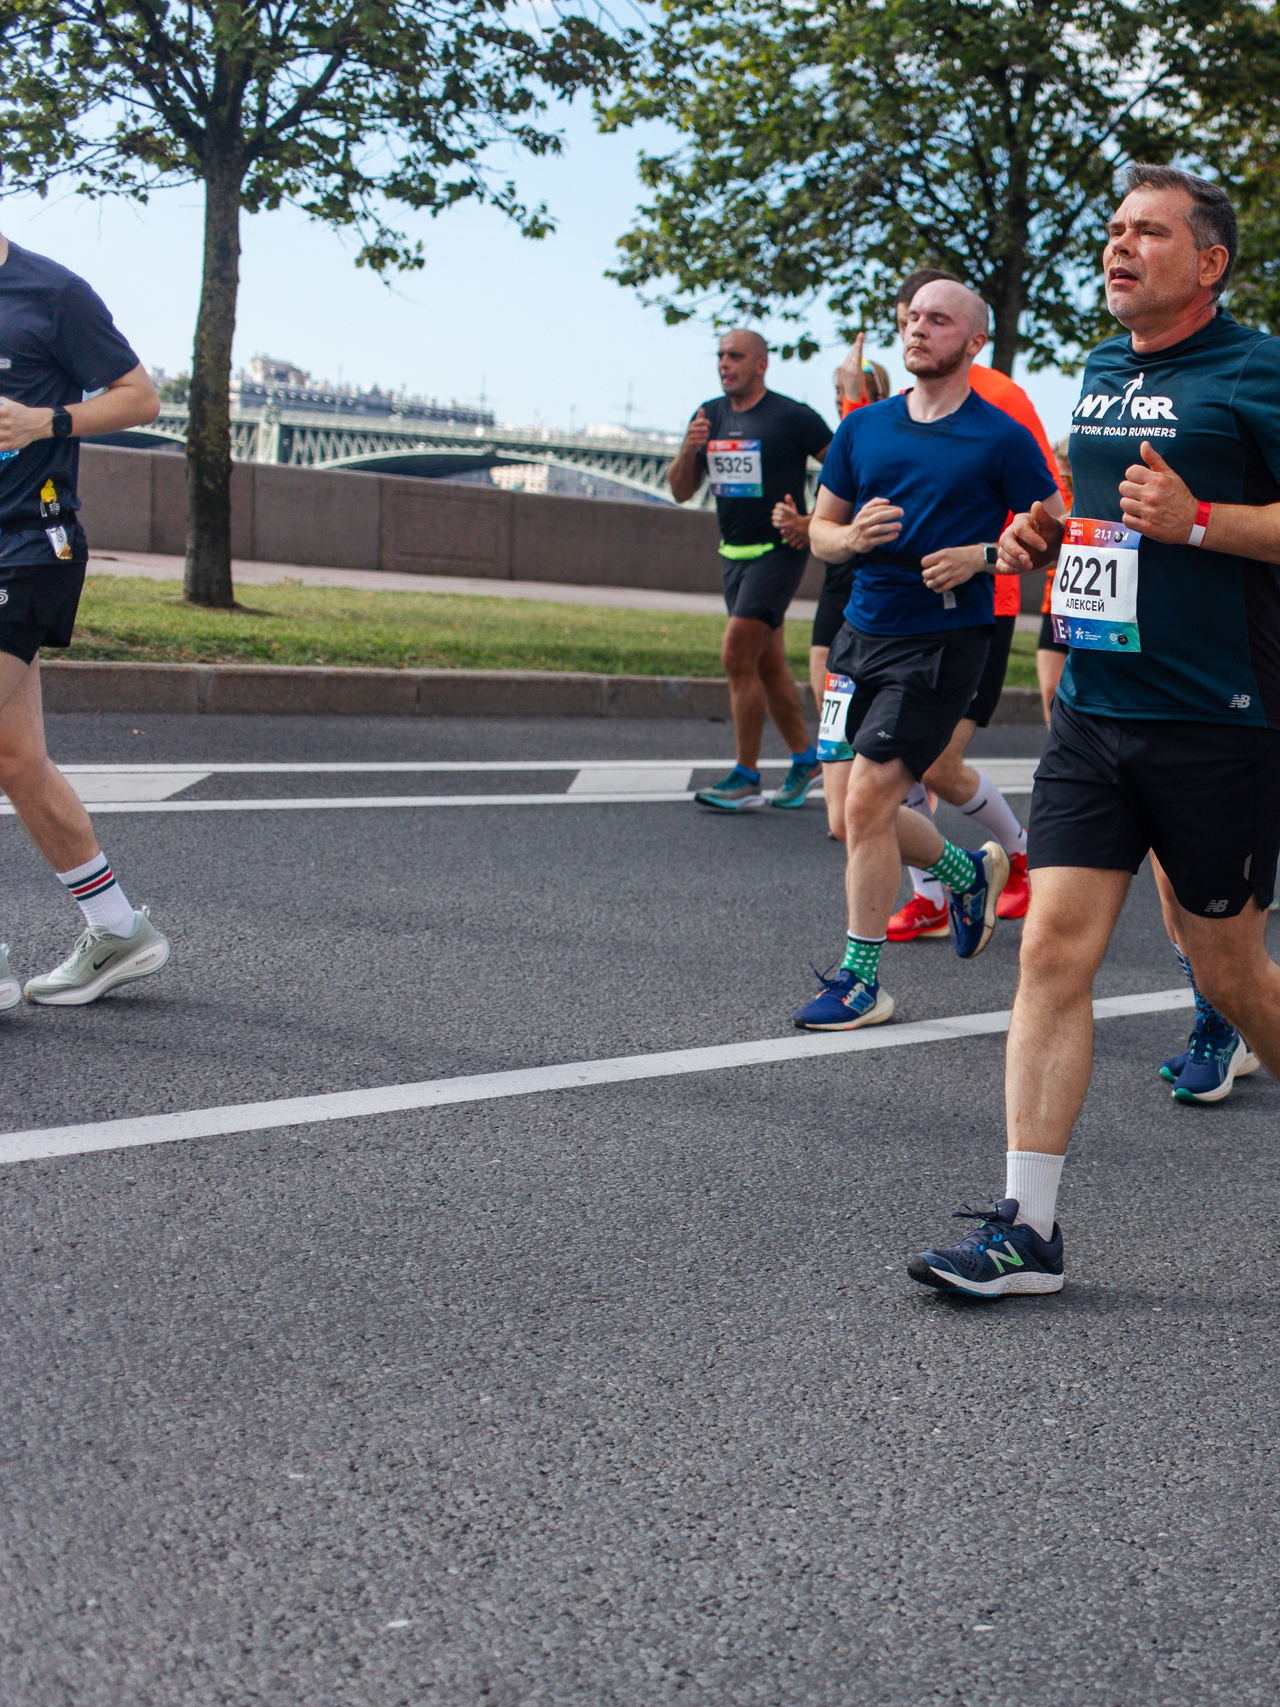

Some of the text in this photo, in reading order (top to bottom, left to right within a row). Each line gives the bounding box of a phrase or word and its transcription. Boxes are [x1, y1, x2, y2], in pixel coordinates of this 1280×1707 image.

[1081, 426, 1103, 436] YORK
[1103, 427, 1128, 437] ROAD
[1128, 427, 1177, 438] RUNNERS
[714, 456, 753, 473] 5325
[1094, 528, 1112, 540] 21,1
[1059, 554, 1118, 598] 6221
[1065, 598, 1105, 613] АЛЕКСЕЙ
